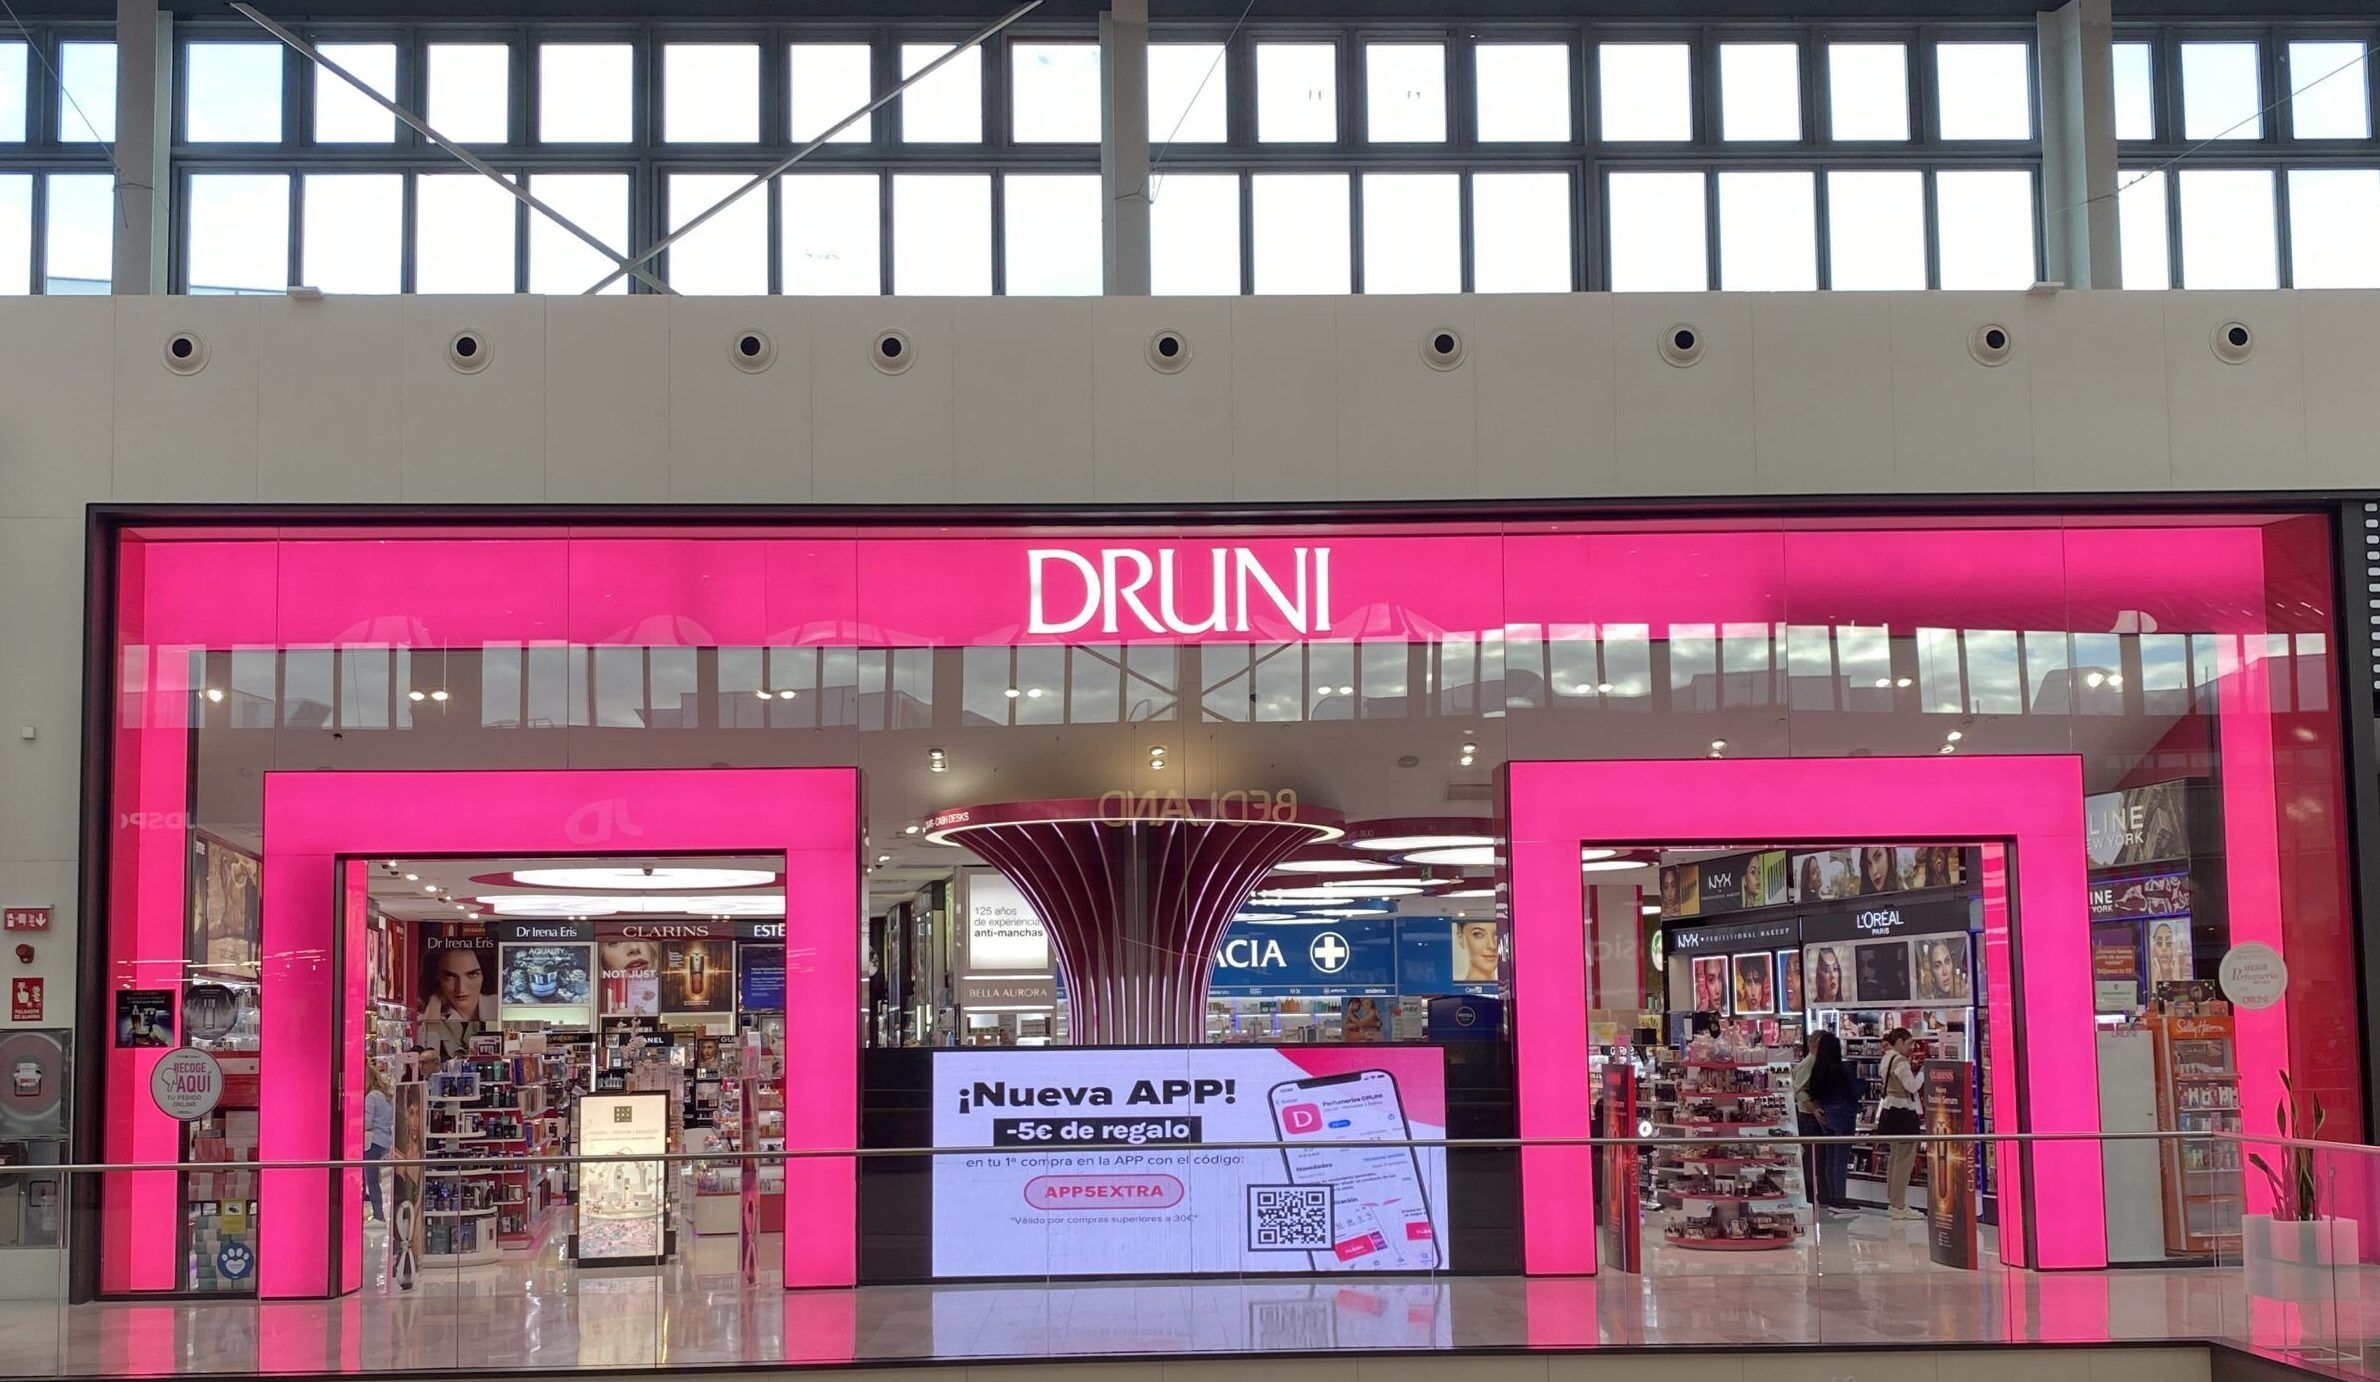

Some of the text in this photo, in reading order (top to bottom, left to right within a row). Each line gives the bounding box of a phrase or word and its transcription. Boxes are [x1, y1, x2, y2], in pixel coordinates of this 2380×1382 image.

[1026, 547, 1333, 634] DRUNI
[2106, 831, 2144, 849] YORK
[1708, 873, 1733, 890] NYX
[974, 906, 1018, 916] 125 años
[974, 918, 1041, 928] de experiencia
[1857, 910, 1904, 928] L'ORÉAL
[516, 926, 577, 937] Dr Irena Eris
[623, 925, 710, 938] CLARINS
[974, 928, 1044, 937] anti-manchas
[427, 937, 494, 949] Dr Irena Eris
[1678, 932, 1699, 948] NYX
[602, 970, 627, 979] NOT
[969, 987, 1048, 998] BELLA AURORA
[174, 1063, 207, 1073] RECOGE
[176, 1070, 212, 1092] AQUÍ
[959, 1079, 1236, 1114] ¡Nueva APP!
[1293, 1110, 1313, 1128] D
[1006, 1119, 1190, 1144] -5€ de regalo
[966, 1160, 983, 1168] en
[987, 1158, 1001, 1168] tu
[1020, 1158, 1072, 1171] compra
[1077, 1158, 1093, 1166] en
[1099, 1155, 1111, 1166] la
[1115, 1155, 1144, 1165] APP
[1148, 1156, 1173, 1165] con
[1177, 1154, 1190, 1165] el
[1194, 1154, 1245, 1168] código:
[1044, 1184, 1164, 1198] APP5EXTRA
[1048, 1218, 1064, 1227] por
[1066, 1216, 1109, 1226] compras
[1111, 1214, 1163, 1225] superiores
